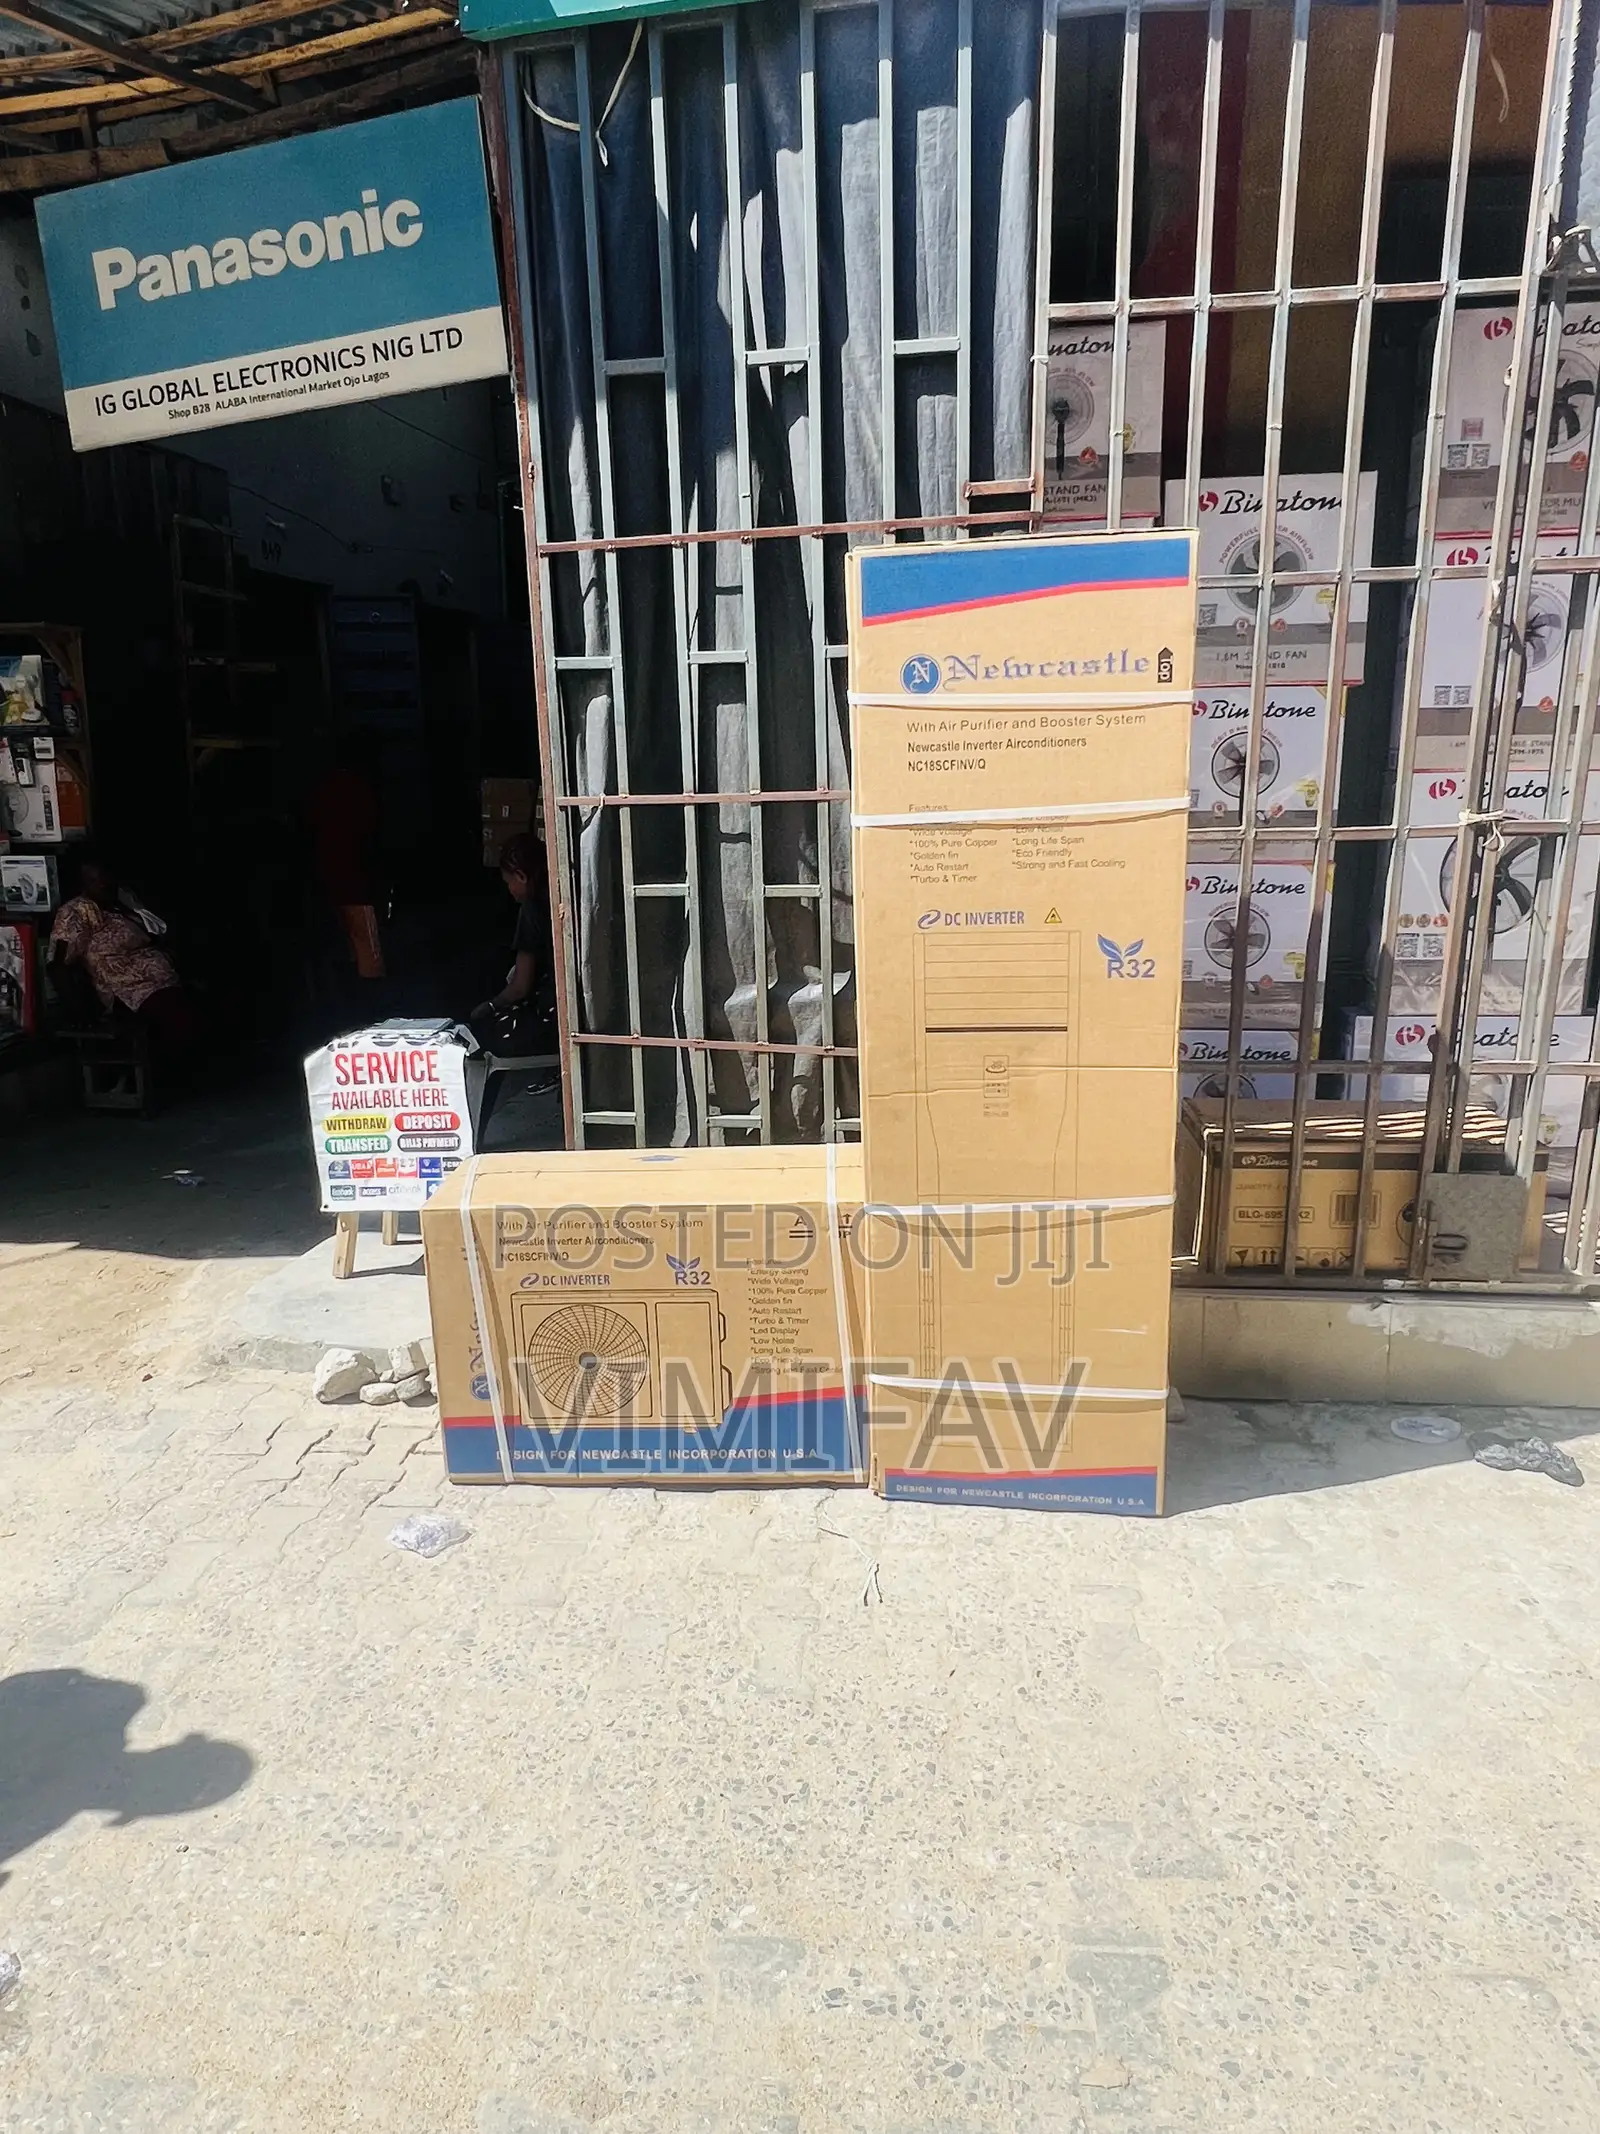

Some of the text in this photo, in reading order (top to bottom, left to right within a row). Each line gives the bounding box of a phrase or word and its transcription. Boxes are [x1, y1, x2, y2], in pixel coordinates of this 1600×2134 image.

[91, 189, 423, 311] Panasonic
[95, 327, 463, 418] IG GLOBAL ELECTRONICS NIG LTD
[168, 370, 391, 420] Shop B28 ALABA International Market Ojo Lagos
[1085, 482, 1106, 493] FAN
[942, 648, 1150, 691] Newcastle
[1208, 699, 1316, 719] Bintone
[906, 713, 1146, 733] With Air Purifier and Booster System
[907, 736, 1087, 754] Newcastle Inverter Airconditioners
[907, 758, 986, 772] NC18SCFINV/Q
[942, 839, 962, 847] Pure
[965, 838, 997, 848] Copper
[1041, 836, 1057, 845] Life
[1060, 836, 1085, 846] Span
[948, 850, 959, 858] fin
[1036, 848, 1072, 858] Friendly
[937, 863, 969, 871] Restart
[1049, 859, 1065, 868] and
[1068, 859, 1088, 868] Fast
[1091, 858, 1125, 869] Cooling
[952, 874, 977, 882] Timer
[944, 910, 1024, 926] DC INVERTER
[1107, 959, 1156, 978] R32
[334, 1050, 440, 1086] SERVICE
[331, 1088, 449, 1110] AVAILABLE HERE
[326, 1115, 453, 1131] WITHDRAW DEPOSIT
[328, 1137, 460, 1153] TRANSFER BILLS PAYMENT
[497, 1218, 703, 1231] With Air Purifier and Booster System
[499, 1235, 655, 1246] Newcastle Inverter Airconditioners
[543, 1274, 610, 1286] DC INVERTER
[675, 1271, 711, 1286] R32
[773, 1277, 804, 1286] Voltage
[776, 1287, 796, 1295] Pure
[797, 1286, 828, 1295] Copper
[782, 1296, 792, 1304] fin
[787, 1316, 809, 1324] Timer
[770, 1326, 800, 1336] Display
[775, 1346, 790, 1354] Life
[792, 1346, 813, 1355] Span
[550, 1450, 577, 1461] FOR
[582, 1450, 662, 1461] NEWCASTLE
[668, 1449, 776, 1460] INCORPORATION
[782, 1448, 818, 1460] U.S.A
[896, 1484, 933, 1494] DESIGN
[936, 1486, 958, 1496] FOR
[962, 1488, 1024, 1500] NEWCASTLE
[1028, 1492, 1113, 1505] INCORPORATION
